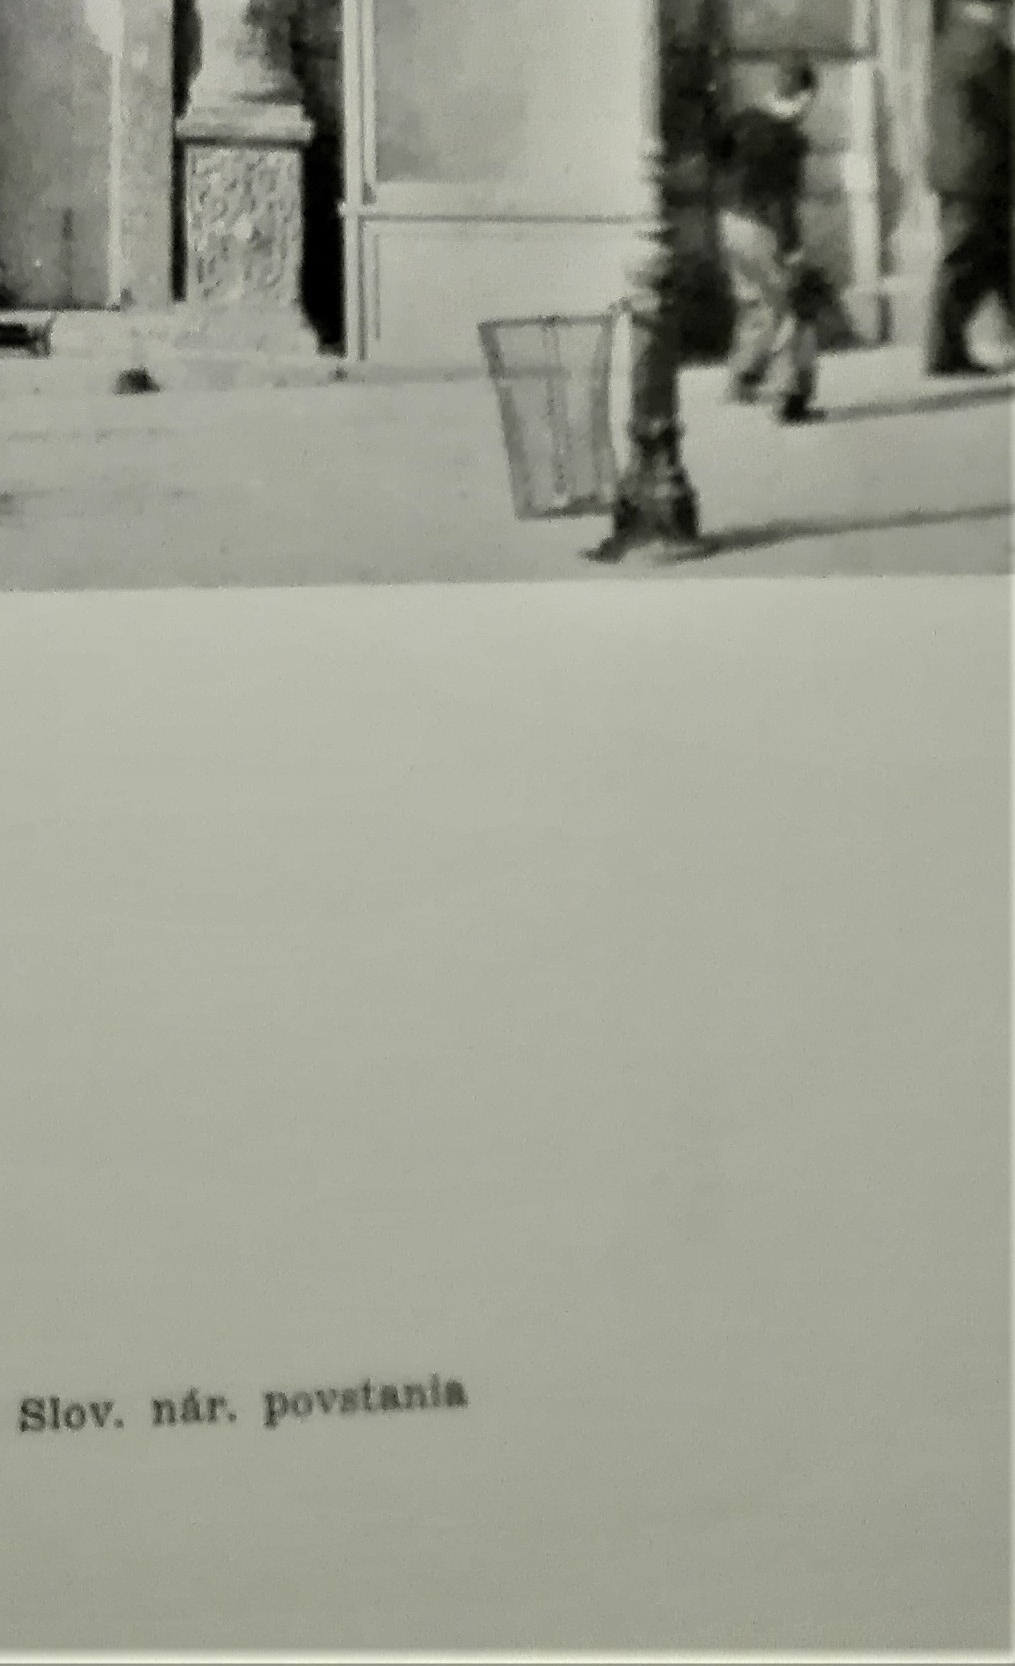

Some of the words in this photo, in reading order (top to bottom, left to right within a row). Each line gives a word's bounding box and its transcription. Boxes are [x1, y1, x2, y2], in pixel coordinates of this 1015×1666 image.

[18, 1395, 125, 1434] Slov.
[151, 1387, 238, 1428] nár.
[263, 1372, 471, 1430] povstania
